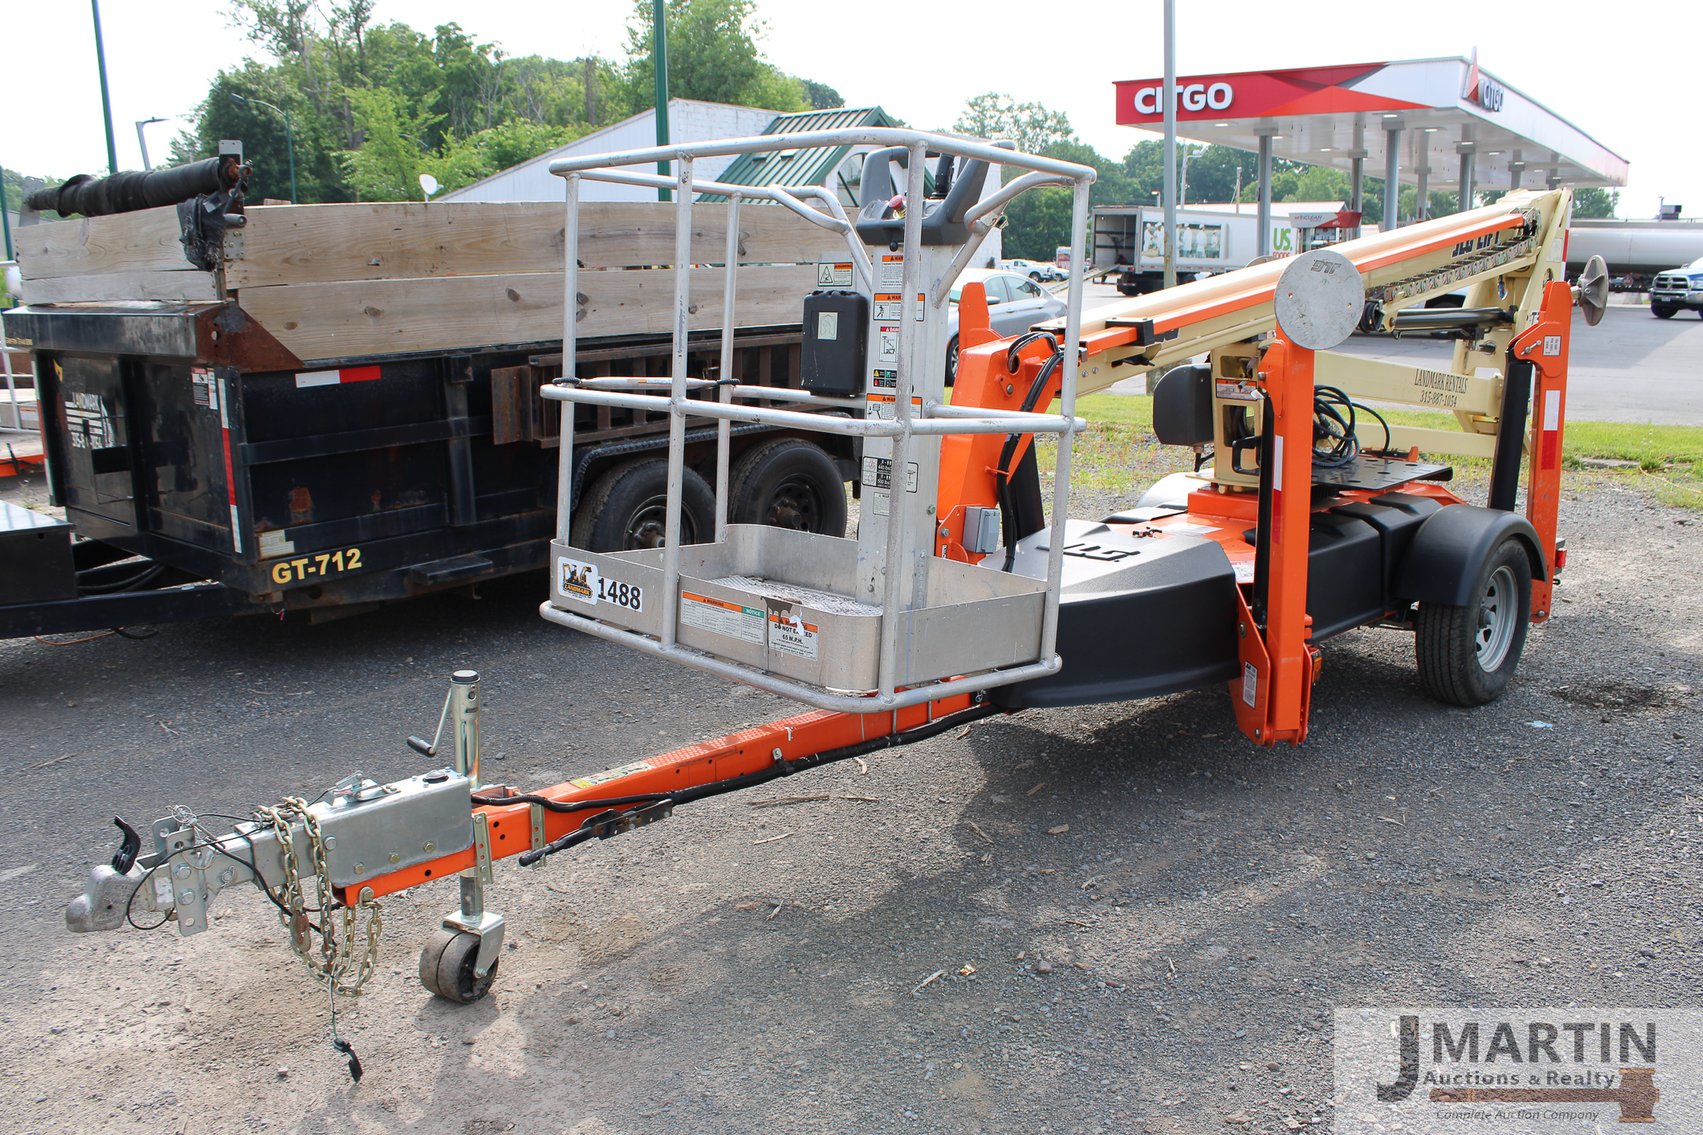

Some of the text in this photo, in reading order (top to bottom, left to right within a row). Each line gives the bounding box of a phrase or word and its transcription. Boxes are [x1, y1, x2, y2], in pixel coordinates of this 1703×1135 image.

[1414, 368, 1469, 394] LANDMARK RENTALS
[271, 547, 362, 585] GT-712
[597, 577, 641, 610] 1488
[745, 608, 761, 617] NOTICE
[782, 625, 793, 634] NOT
